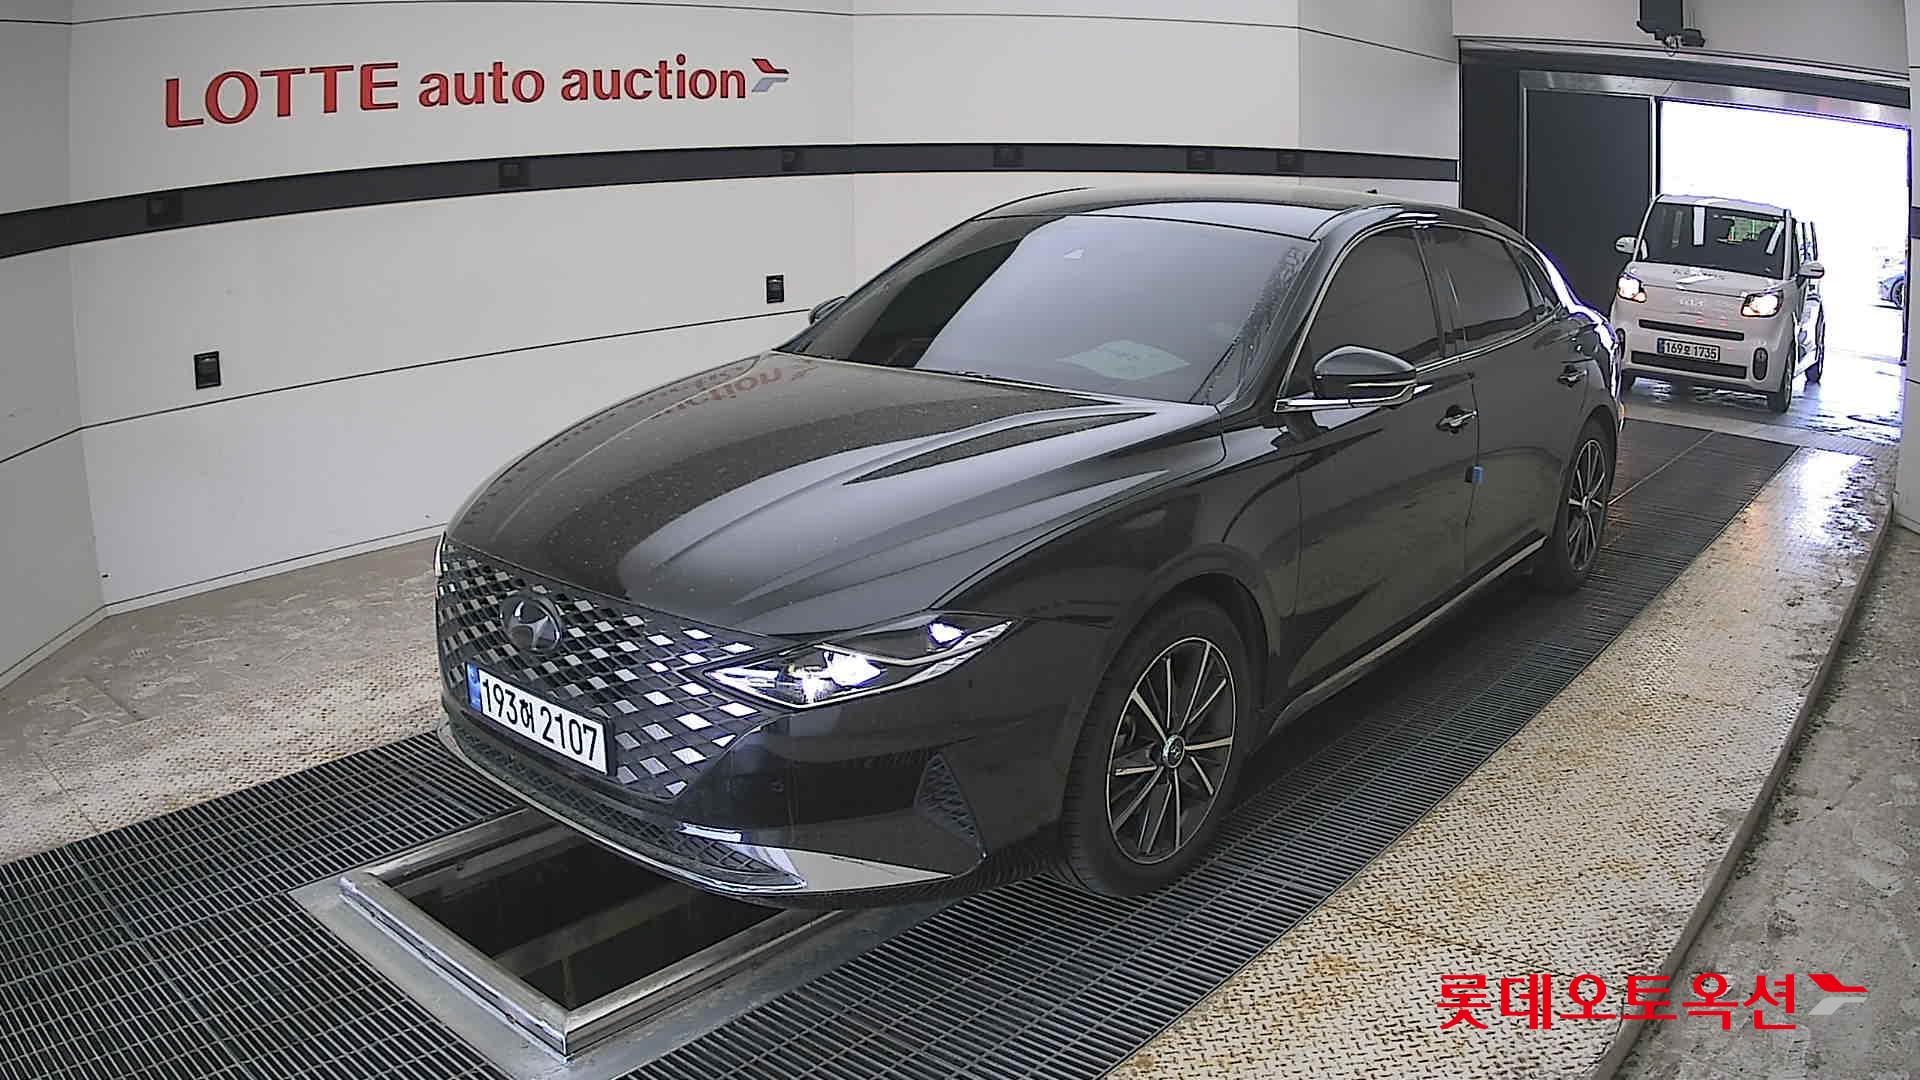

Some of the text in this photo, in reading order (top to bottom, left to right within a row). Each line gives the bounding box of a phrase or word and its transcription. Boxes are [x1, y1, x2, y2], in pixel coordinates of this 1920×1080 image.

[165, 53, 747, 128] LOTTE auto auction
[1694, 346, 1717, 359] 1735
[482, 678, 597, 761] 193허 2107
